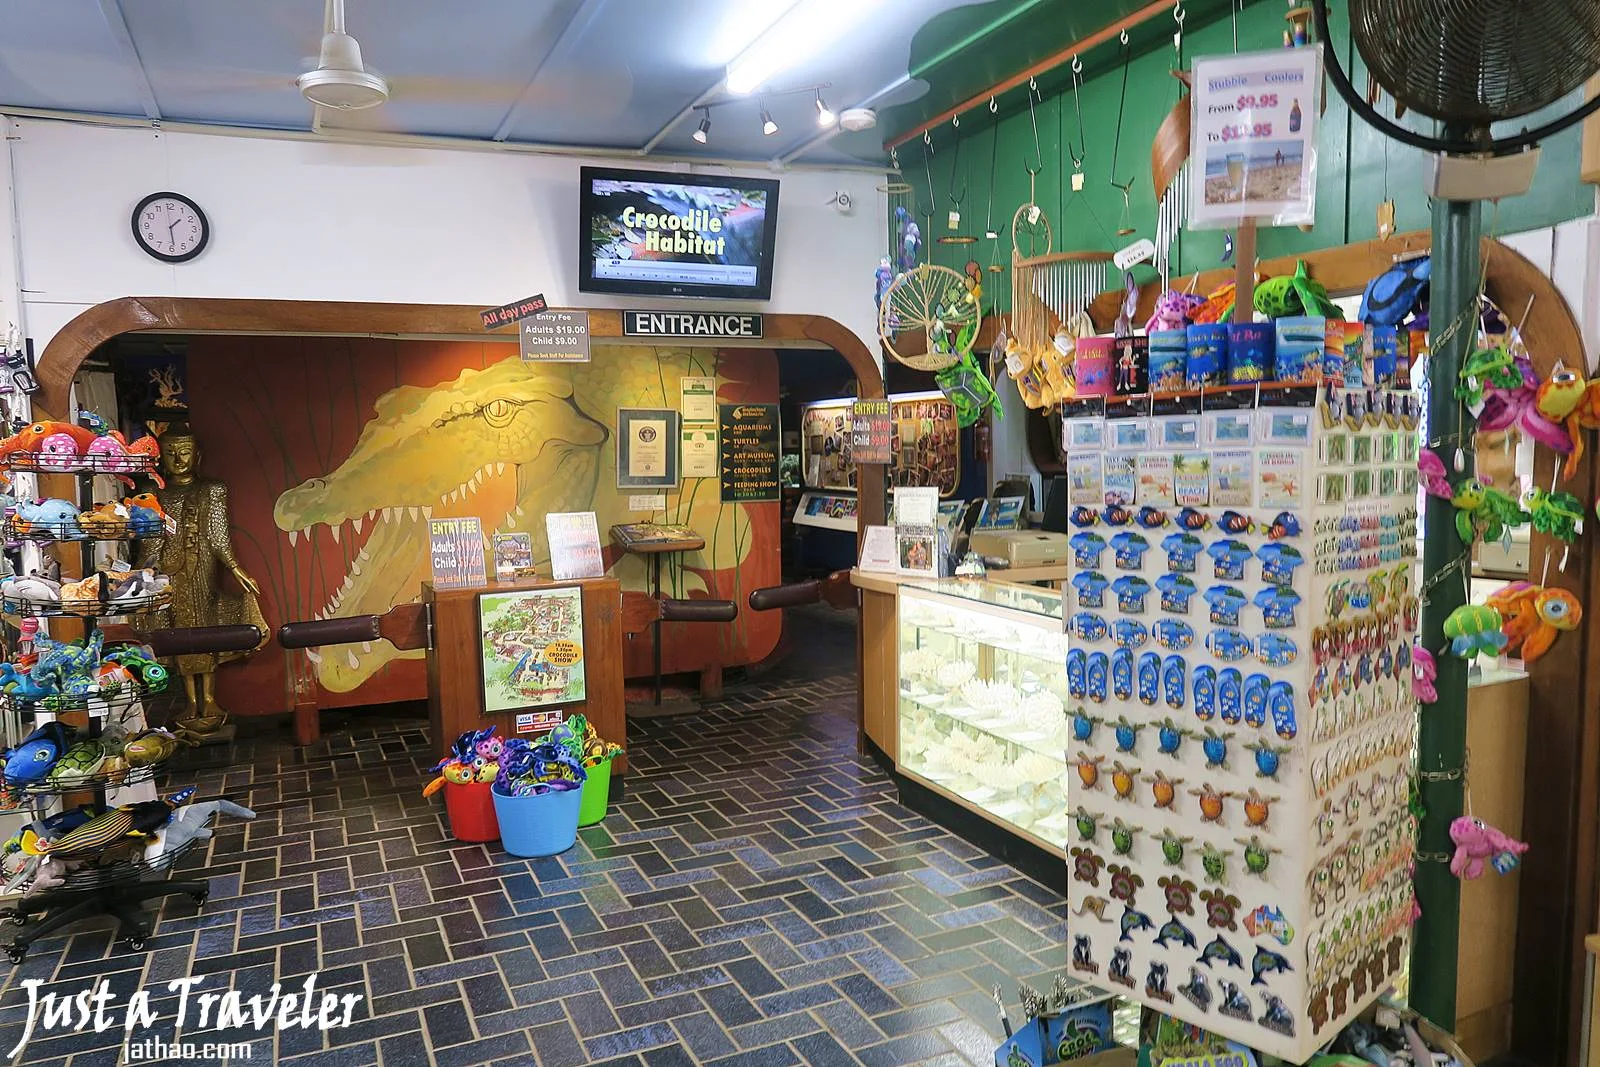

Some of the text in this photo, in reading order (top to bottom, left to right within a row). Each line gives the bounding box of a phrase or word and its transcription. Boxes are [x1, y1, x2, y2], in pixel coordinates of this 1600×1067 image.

[1208, 94, 1278, 114] From $9.95
[1207, 132, 1219, 142] To
[622, 206, 722, 233] Crocodile
[191, 225, 197, 233] 3
[181, 242, 186, 250] 5
[645, 231, 725, 255] Habitat
[483, 299, 544, 326] All day pass
[525, 325, 586, 334] Adults $19.00
[635, 313, 753, 335] ENTRANCE
[532, 337, 577, 345] Child $9.00
[854, 402, 888, 415] ENTRY FEE
[853, 419, 870, 432] Adults
[853, 434, 869, 446] Child
[431, 521, 477, 535] ENTRY FEE
[431, 541, 456, 553] Adults
[434, 557, 457, 569] Child
